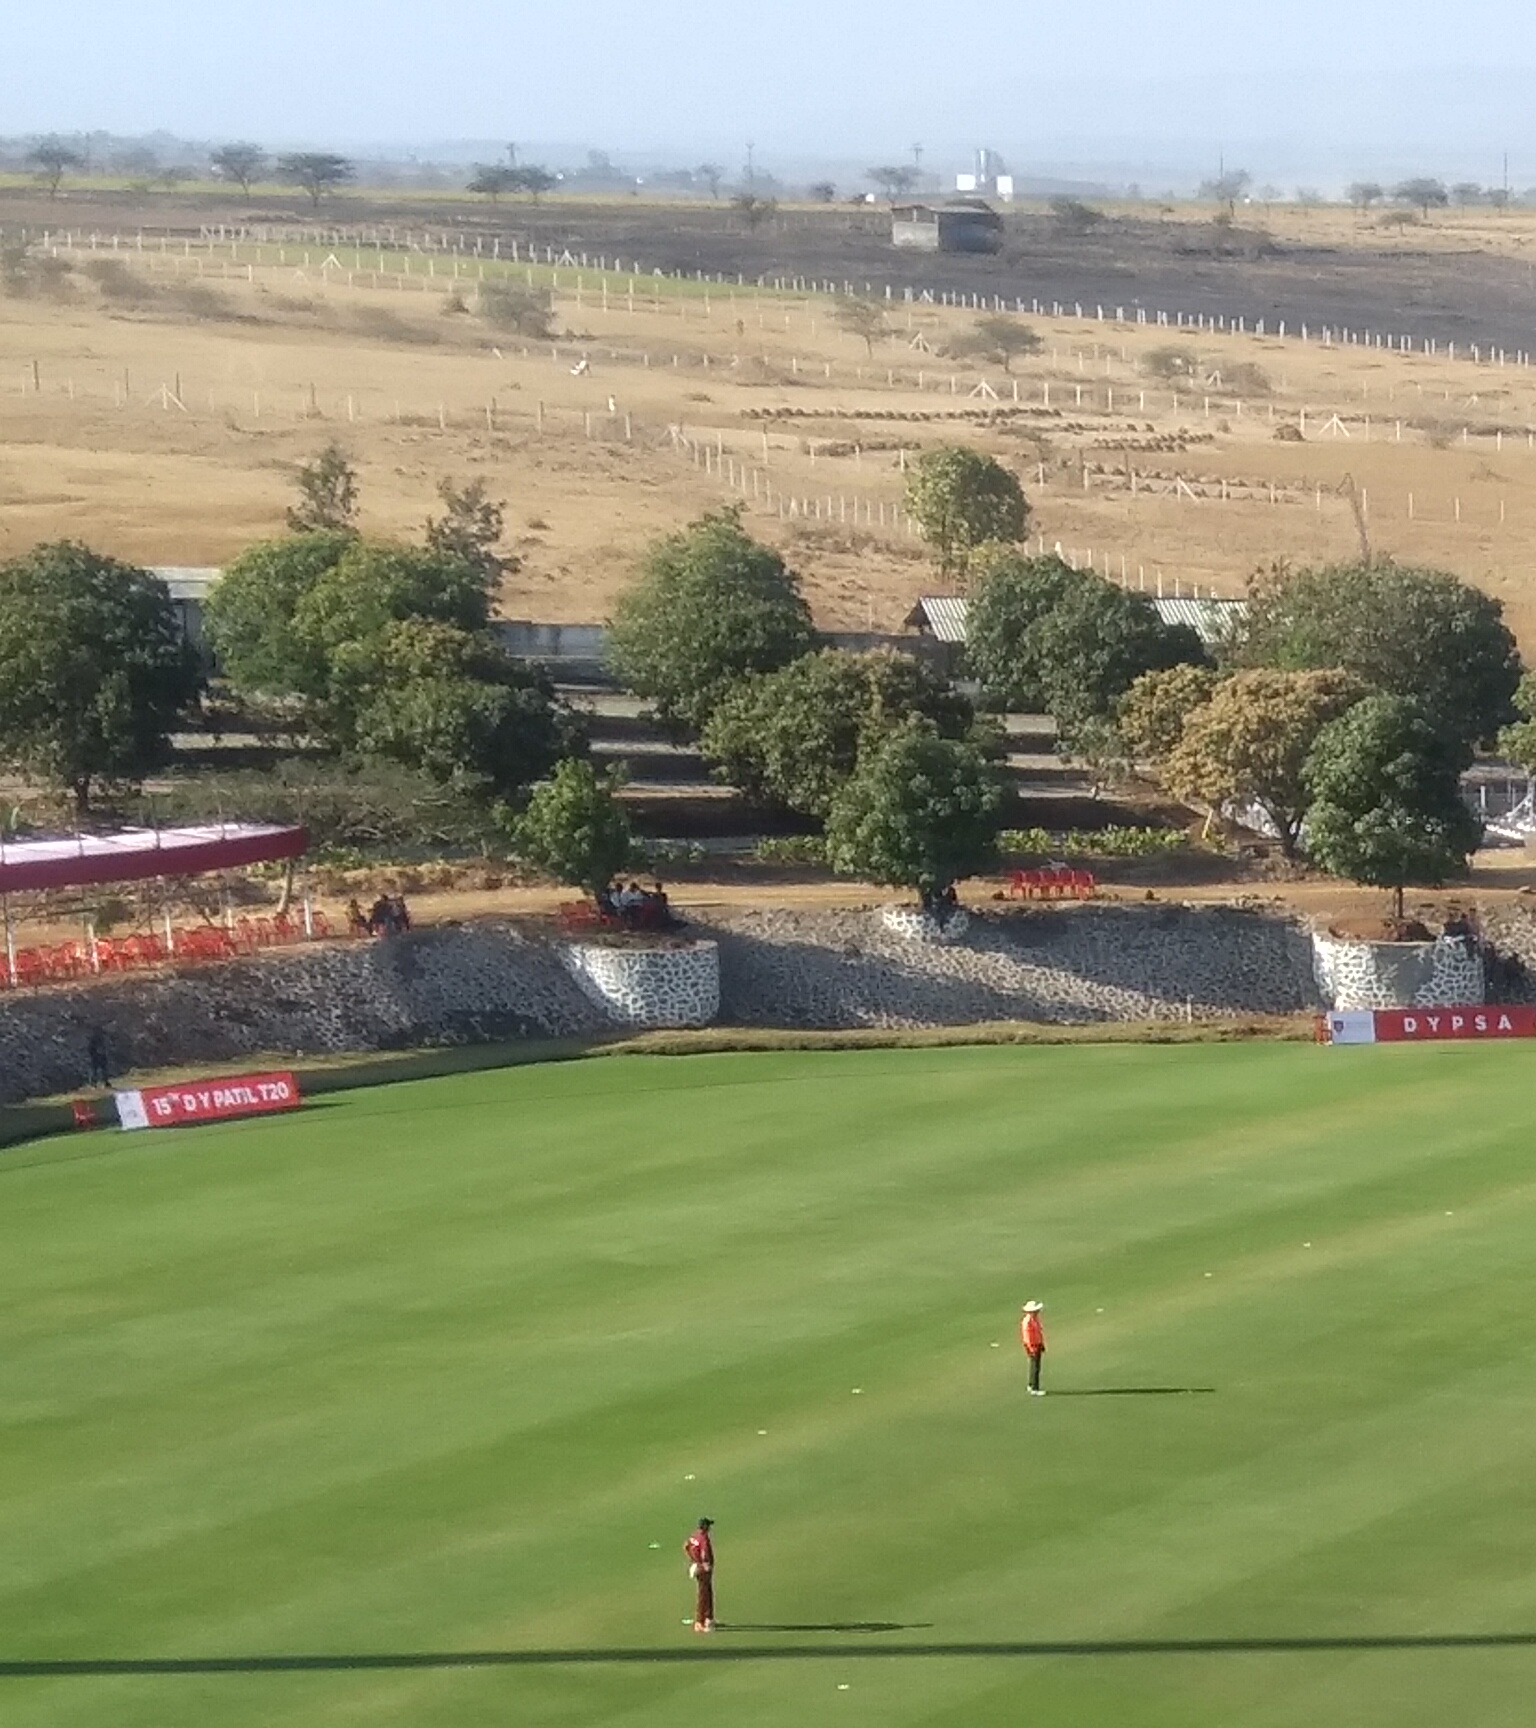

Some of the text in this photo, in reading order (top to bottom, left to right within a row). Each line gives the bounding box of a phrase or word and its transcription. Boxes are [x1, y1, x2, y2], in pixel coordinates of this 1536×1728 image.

[1403, 1014, 1512, 1032] DYPSA
[182, 1094, 197, 1111] D
[196, 1092, 209, 1108] Y
[212, 1087, 259, 1107] PATIL
[257, 1081, 289, 1101] T20
